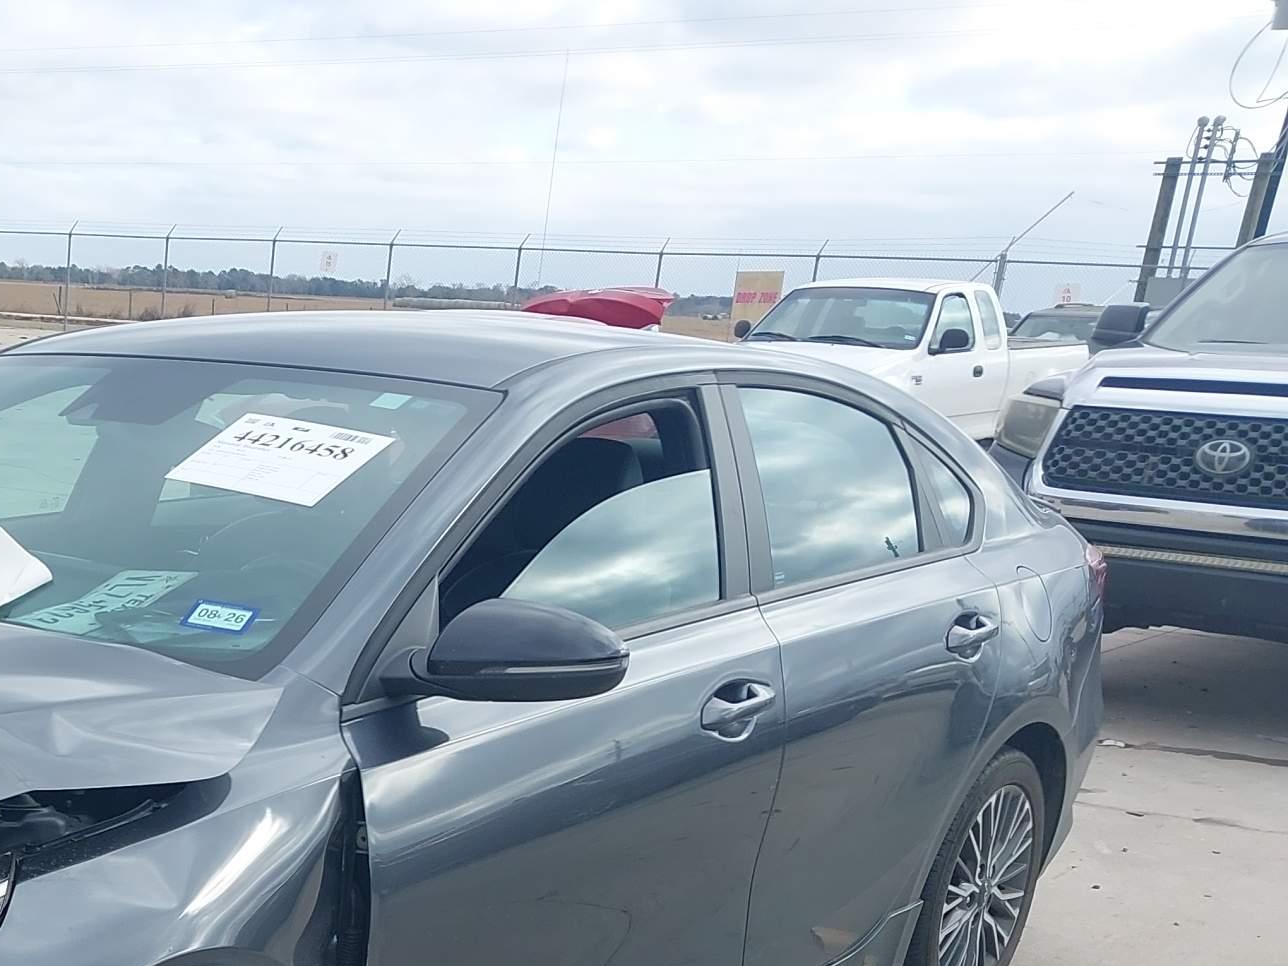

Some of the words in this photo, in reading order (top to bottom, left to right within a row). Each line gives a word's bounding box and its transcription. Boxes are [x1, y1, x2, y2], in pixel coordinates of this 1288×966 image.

[735, 291, 757, 304] DROP
[758, 291, 779, 304] ZONE
[232, 429, 356, 462] 44216458
[197, 608, 219, 620] 08
[223, 612, 247, 624] 26
